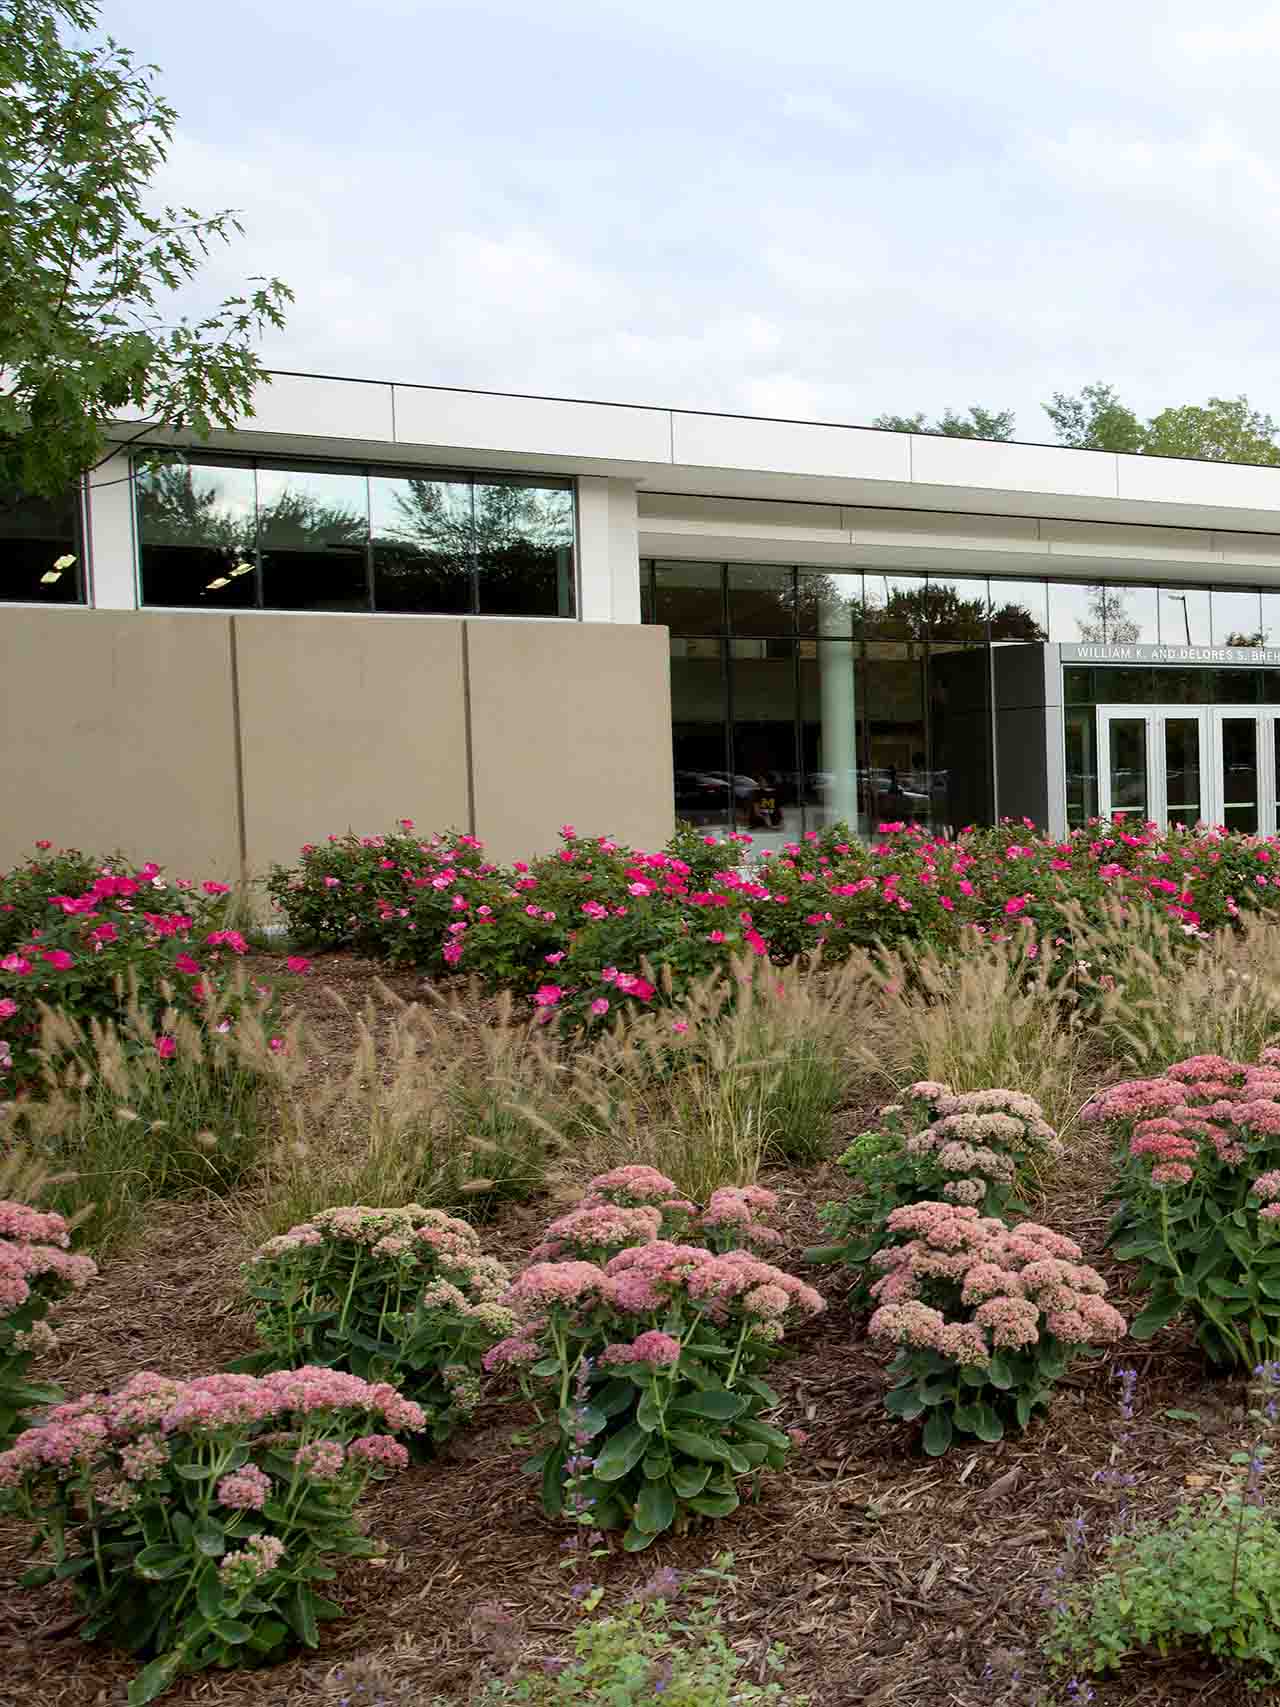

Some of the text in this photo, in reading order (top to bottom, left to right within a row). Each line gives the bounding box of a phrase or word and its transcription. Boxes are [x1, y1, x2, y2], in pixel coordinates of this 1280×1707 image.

[1077, 647, 1129, 658] WILLIAM
[1152, 649, 1175, 659] AND
[1180, 649, 1232, 660] DELORES
